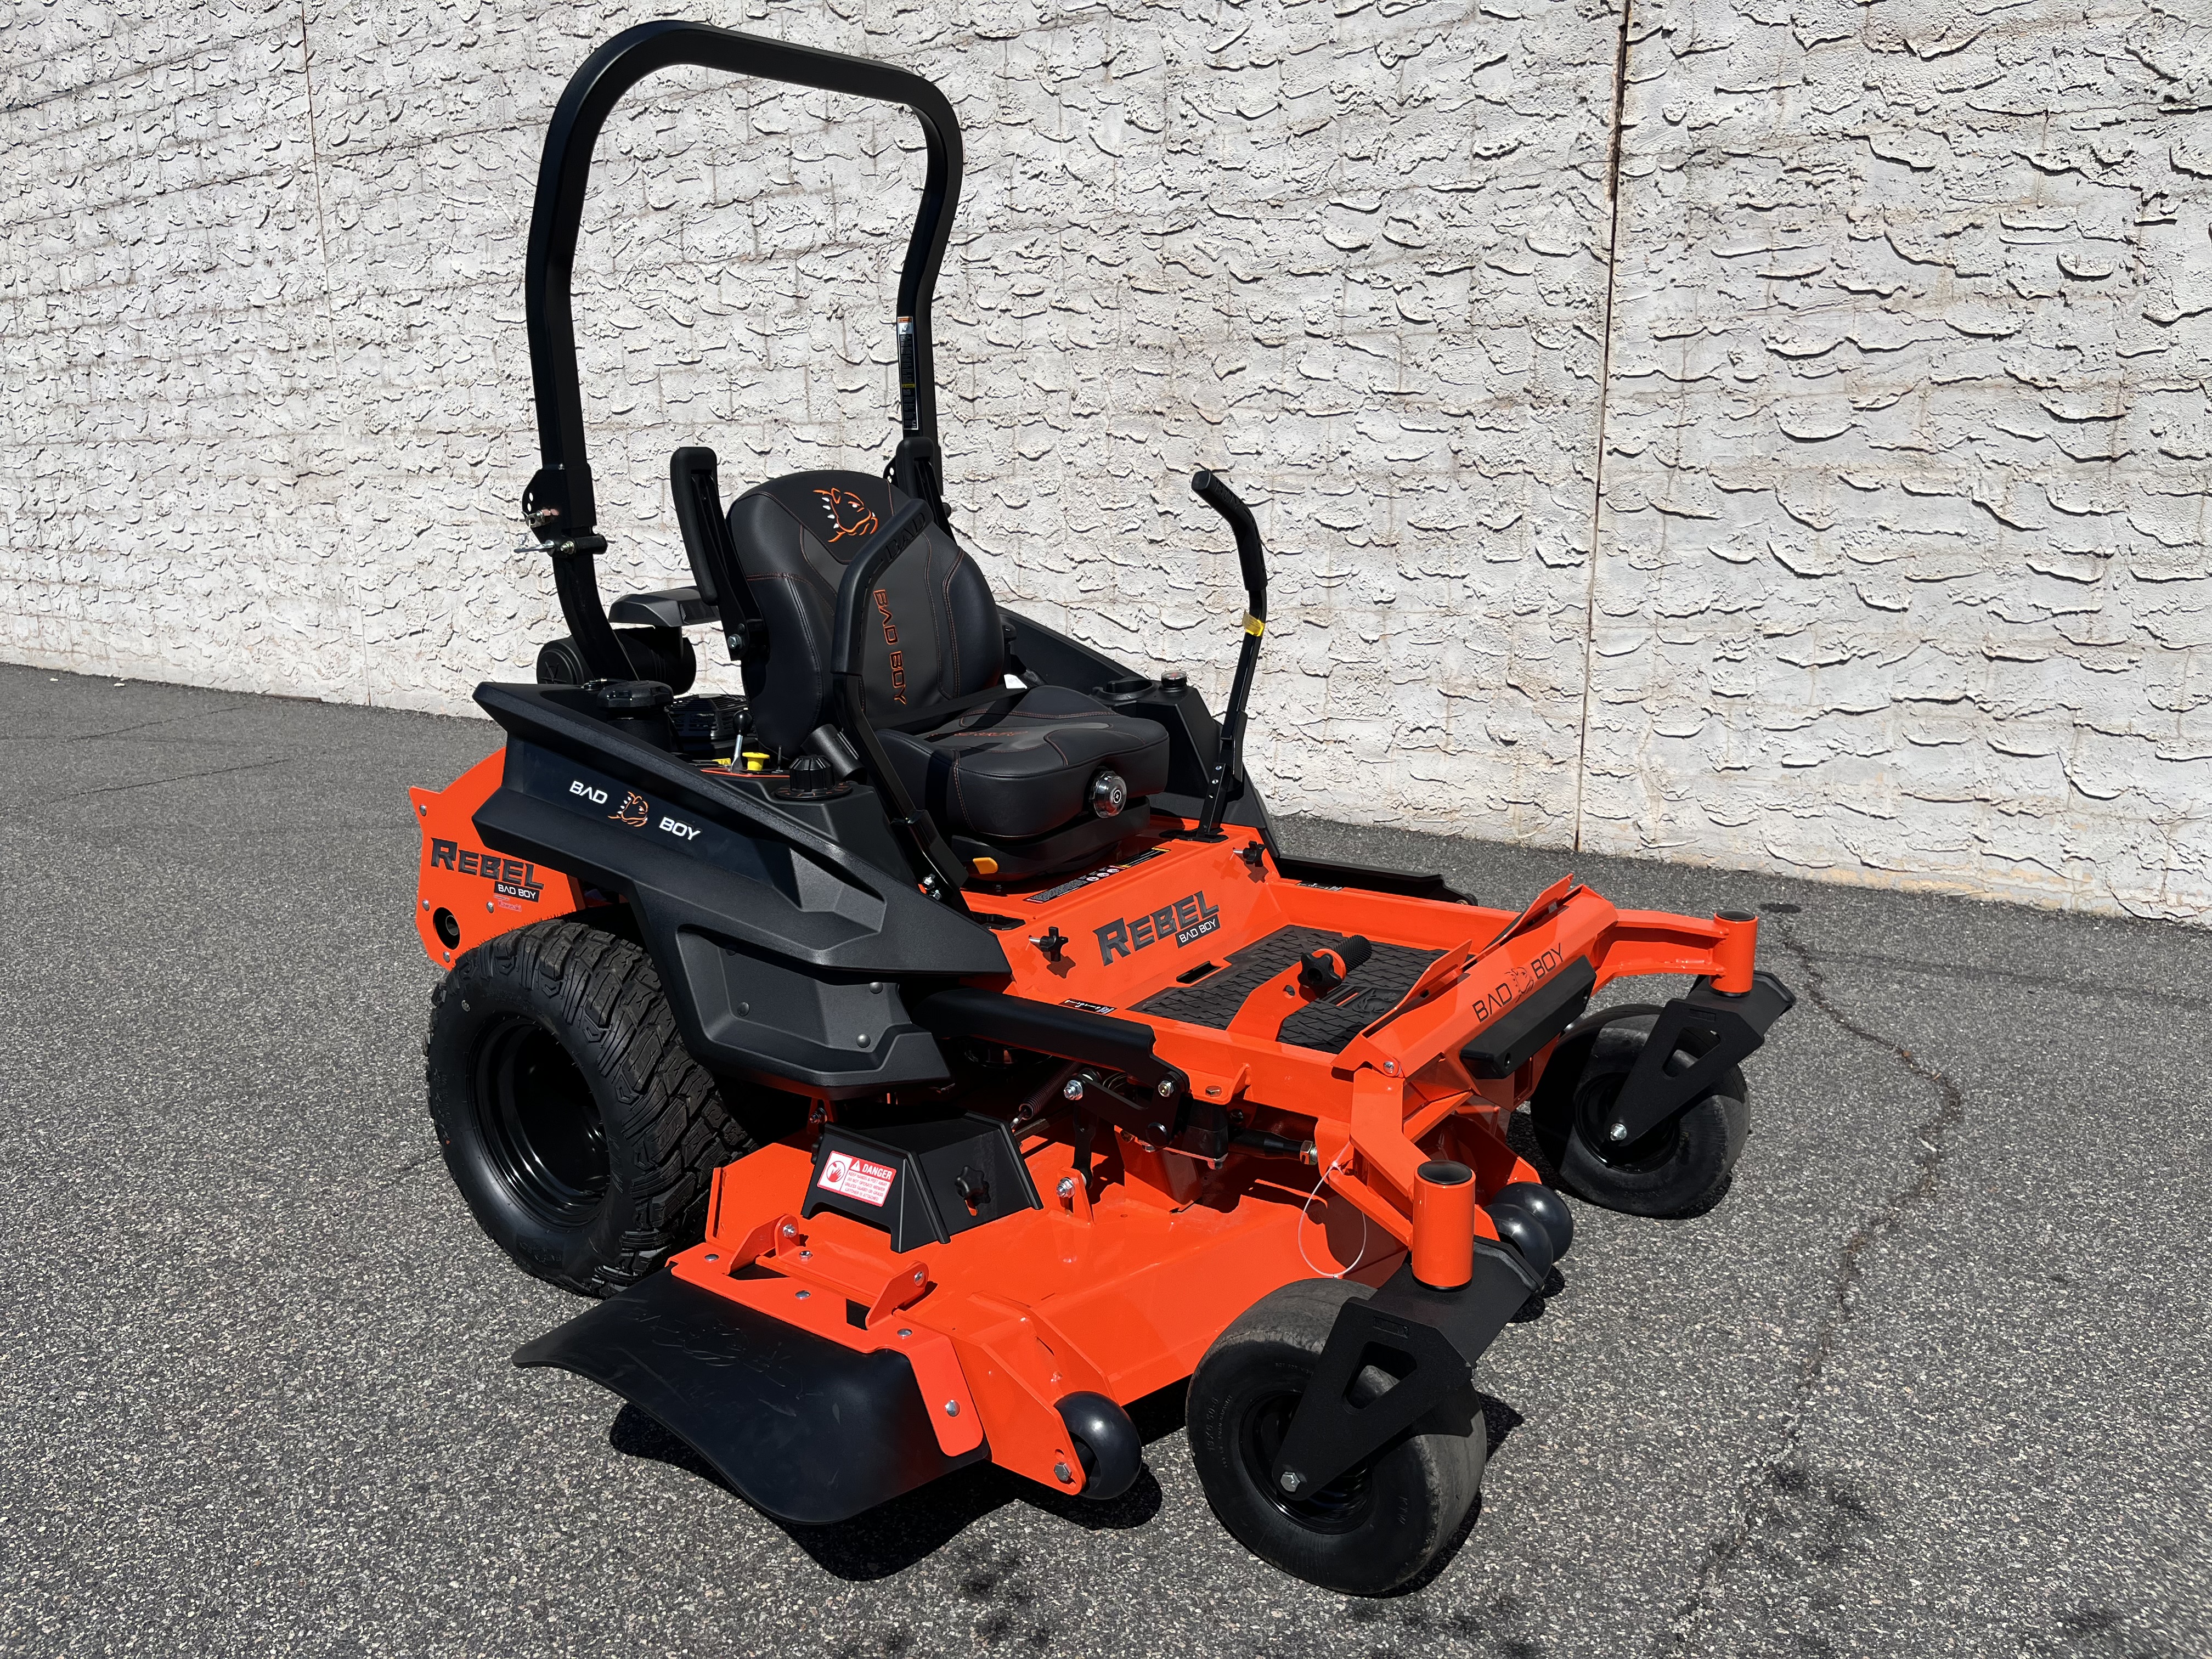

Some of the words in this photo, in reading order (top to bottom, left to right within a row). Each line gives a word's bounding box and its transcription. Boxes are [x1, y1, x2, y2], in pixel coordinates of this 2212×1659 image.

[873, 589, 898, 645] BAD
[890, 651, 906, 704] BOY
[569, 781, 608, 804] BAD
[659, 816, 701, 840] BOY
[431, 837, 544, 890] REBEL
[498, 884, 516, 895] BAD
[518, 889, 536, 899] BOY
[1093, 890, 1219, 967] REBEL
[1179, 928, 1198, 943] BAD
[1198, 919, 1216, 934] BOY
[1472, 983, 1513, 1023] BAD
[1530, 942, 1564, 980] BOY
[861, 1163, 893, 1180] DANGER
